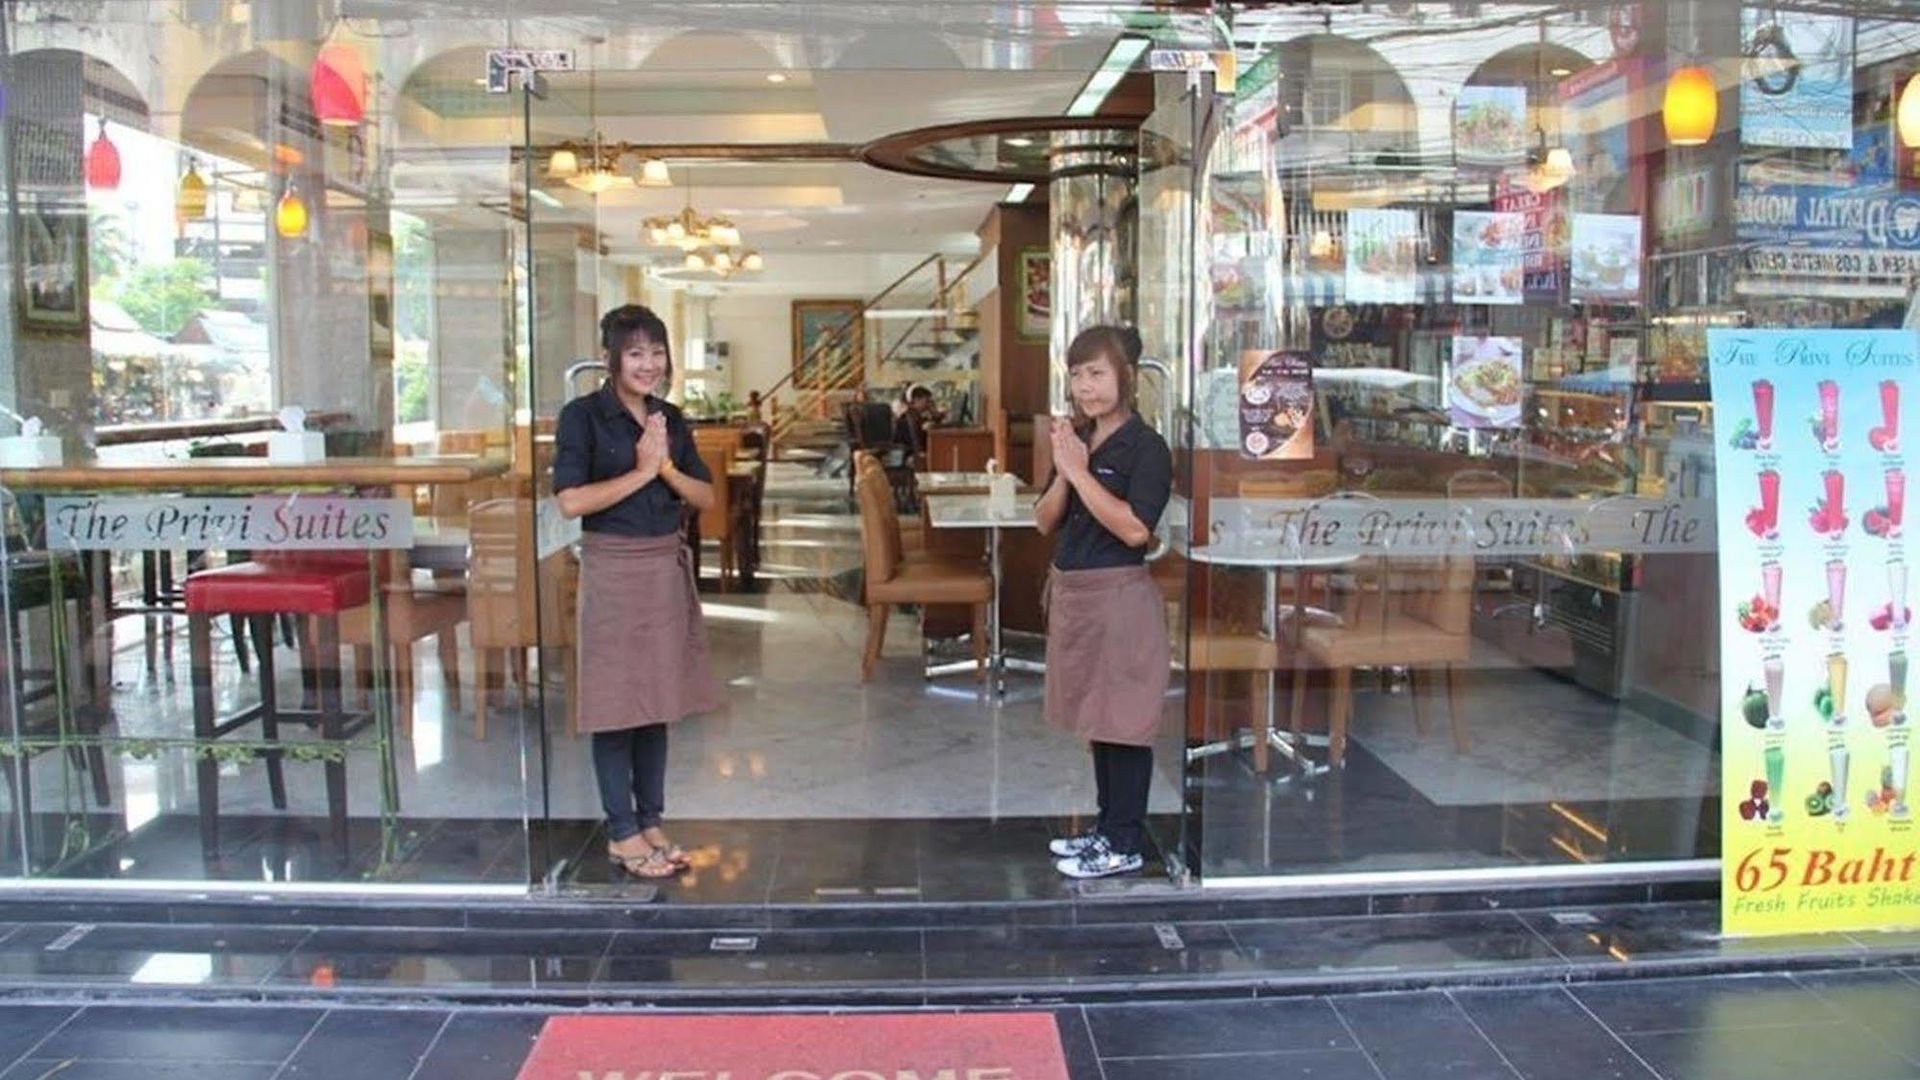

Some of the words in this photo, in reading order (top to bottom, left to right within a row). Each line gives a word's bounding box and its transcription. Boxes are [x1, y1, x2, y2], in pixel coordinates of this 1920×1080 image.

[56, 501, 129, 541] The
[265, 503, 391, 544] Suites
[1268, 504, 1341, 546] The
[1630, 503, 1700, 546] The
[1736, 847, 1792, 892] 65
[1801, 847, 1916, 886] Baht
[1734, 895, 1786, 915] Fresh
[1797, 890, 1856, 912] Fruits
